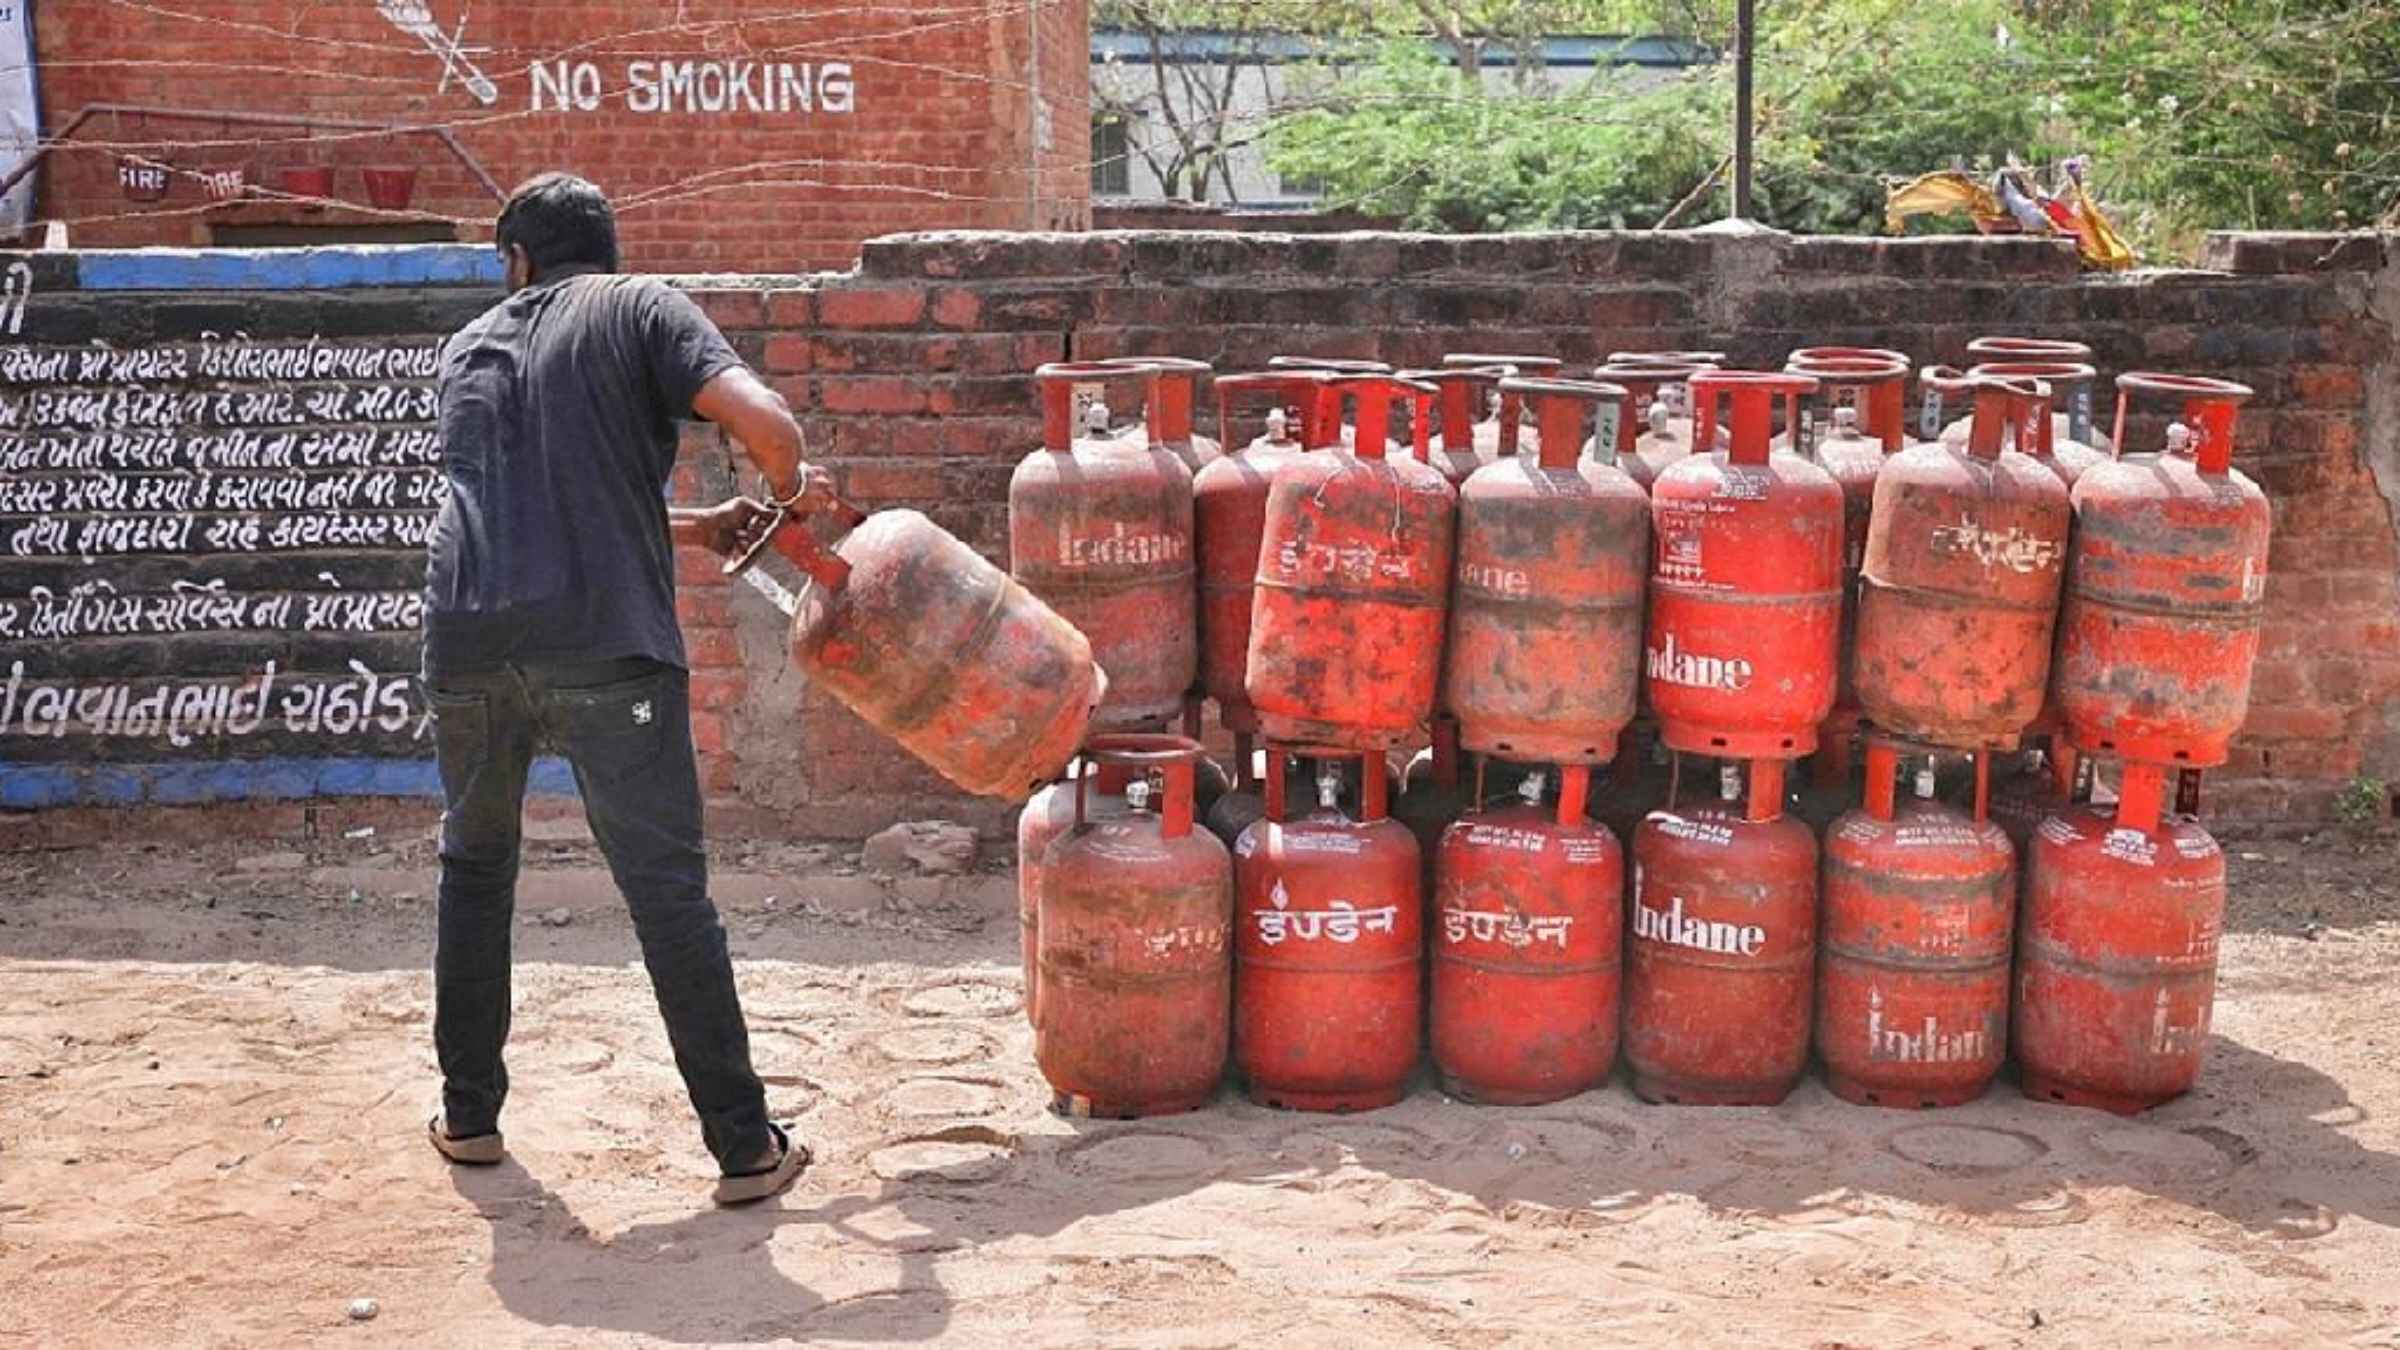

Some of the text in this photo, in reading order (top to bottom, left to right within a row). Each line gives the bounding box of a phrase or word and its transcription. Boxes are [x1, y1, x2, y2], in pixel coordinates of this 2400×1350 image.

[529, 59, 856, 113] NO SMOKING
[118, 167, 166, 190] FIRE
[1633, 885, 1767, 958] Indane
